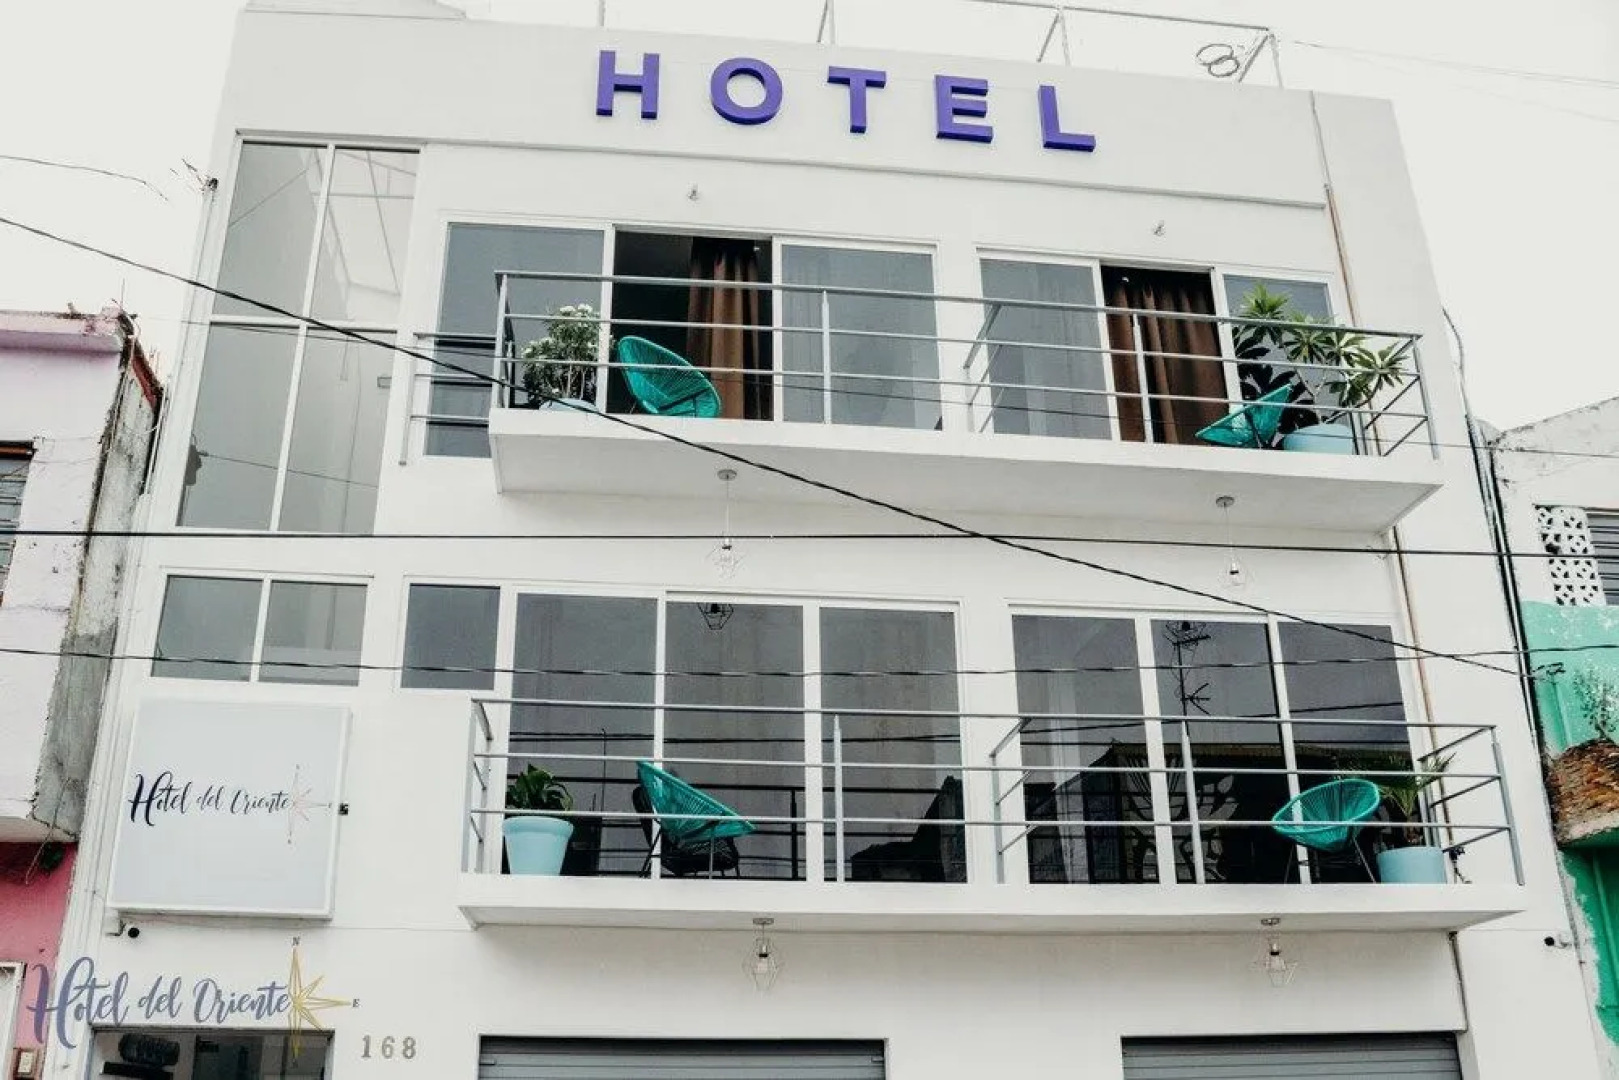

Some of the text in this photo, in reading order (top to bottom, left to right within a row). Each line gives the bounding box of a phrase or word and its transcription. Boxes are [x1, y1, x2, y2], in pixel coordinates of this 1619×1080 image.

[596, 50, 1096, 153] HOTEL
[128, 771, 192, 826] Hotel
[196, 785, 224, 811] del
[361, 1034, 417, 1060] 168
